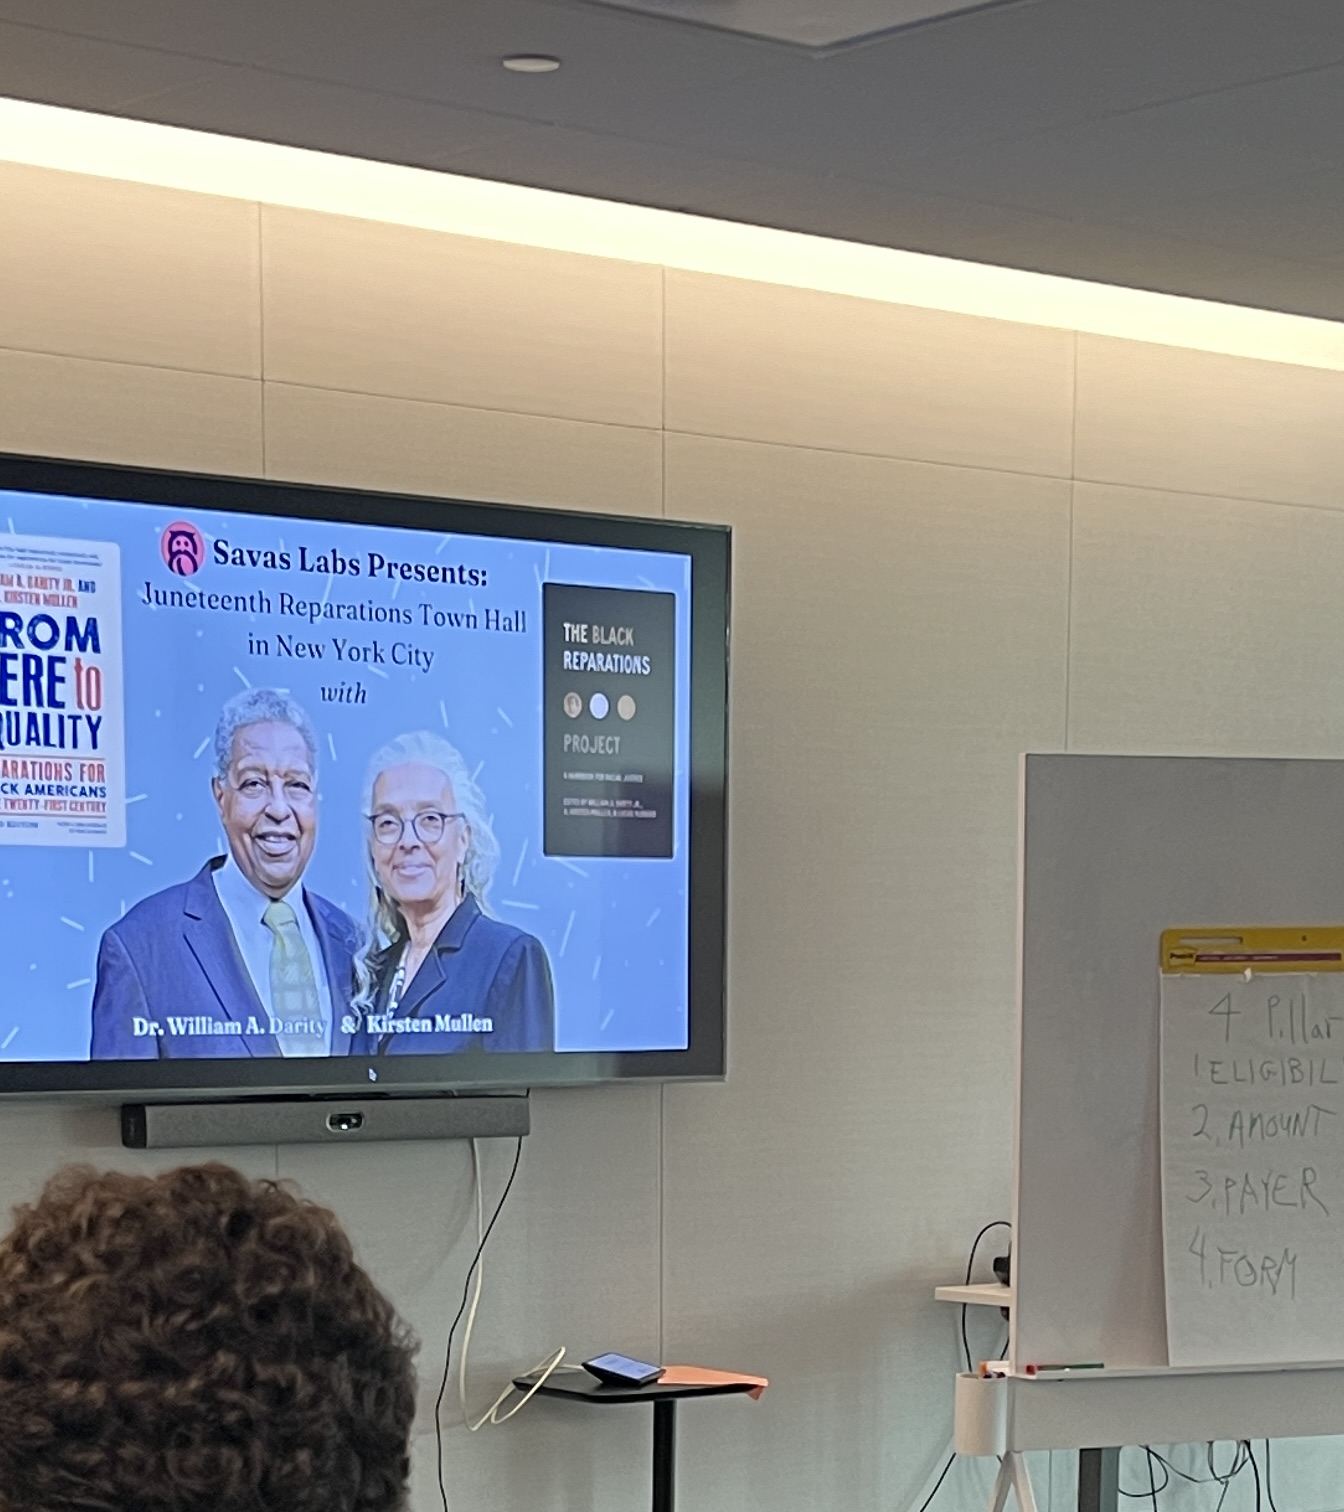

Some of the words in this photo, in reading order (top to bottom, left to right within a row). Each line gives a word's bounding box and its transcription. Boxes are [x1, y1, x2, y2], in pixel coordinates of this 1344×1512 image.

[213, 539, 291, 570] Savas
[298, 546, 360, 576] Labs
[368, 552, 487, 587] Presents:
[141, 581, 272, 614] Juneteenth
[279, 592, 412, 625] Reparations
[418, 603, 477, 630] Town
[485, 608, 526, 633] Hall
[563, 622, 588, 643] THE
[592, 625, 634, 646] BLACK
[248, 632, 269, 656] in
[276, 635, 325, 659] New
[332, 638, 385, 664] York
[391, 642, 435, 673] City
[563, 651, 651, 675] REPARATIONS
[74, 657, 102, 711] to
[320, 681, 367, 704] with
[563, 733, 620, 755] PROJECT
[79, 763, 106, 783] FOR
[24, 784, 107, 798] AMERICANS
[133, 1017, 164, 1036] Dr.
[168, 1017, 242, 1035] William
[245, 1018, 264, 1035] A.
[269, 1018, 327, 1038] Darity
[341, 1017, 358, 1034] &
[366, 1015, 432, 1033] Kirsten
[434, 1014, 493, 1033] Mullen
[1209, 993, 1241, 1042] 4
